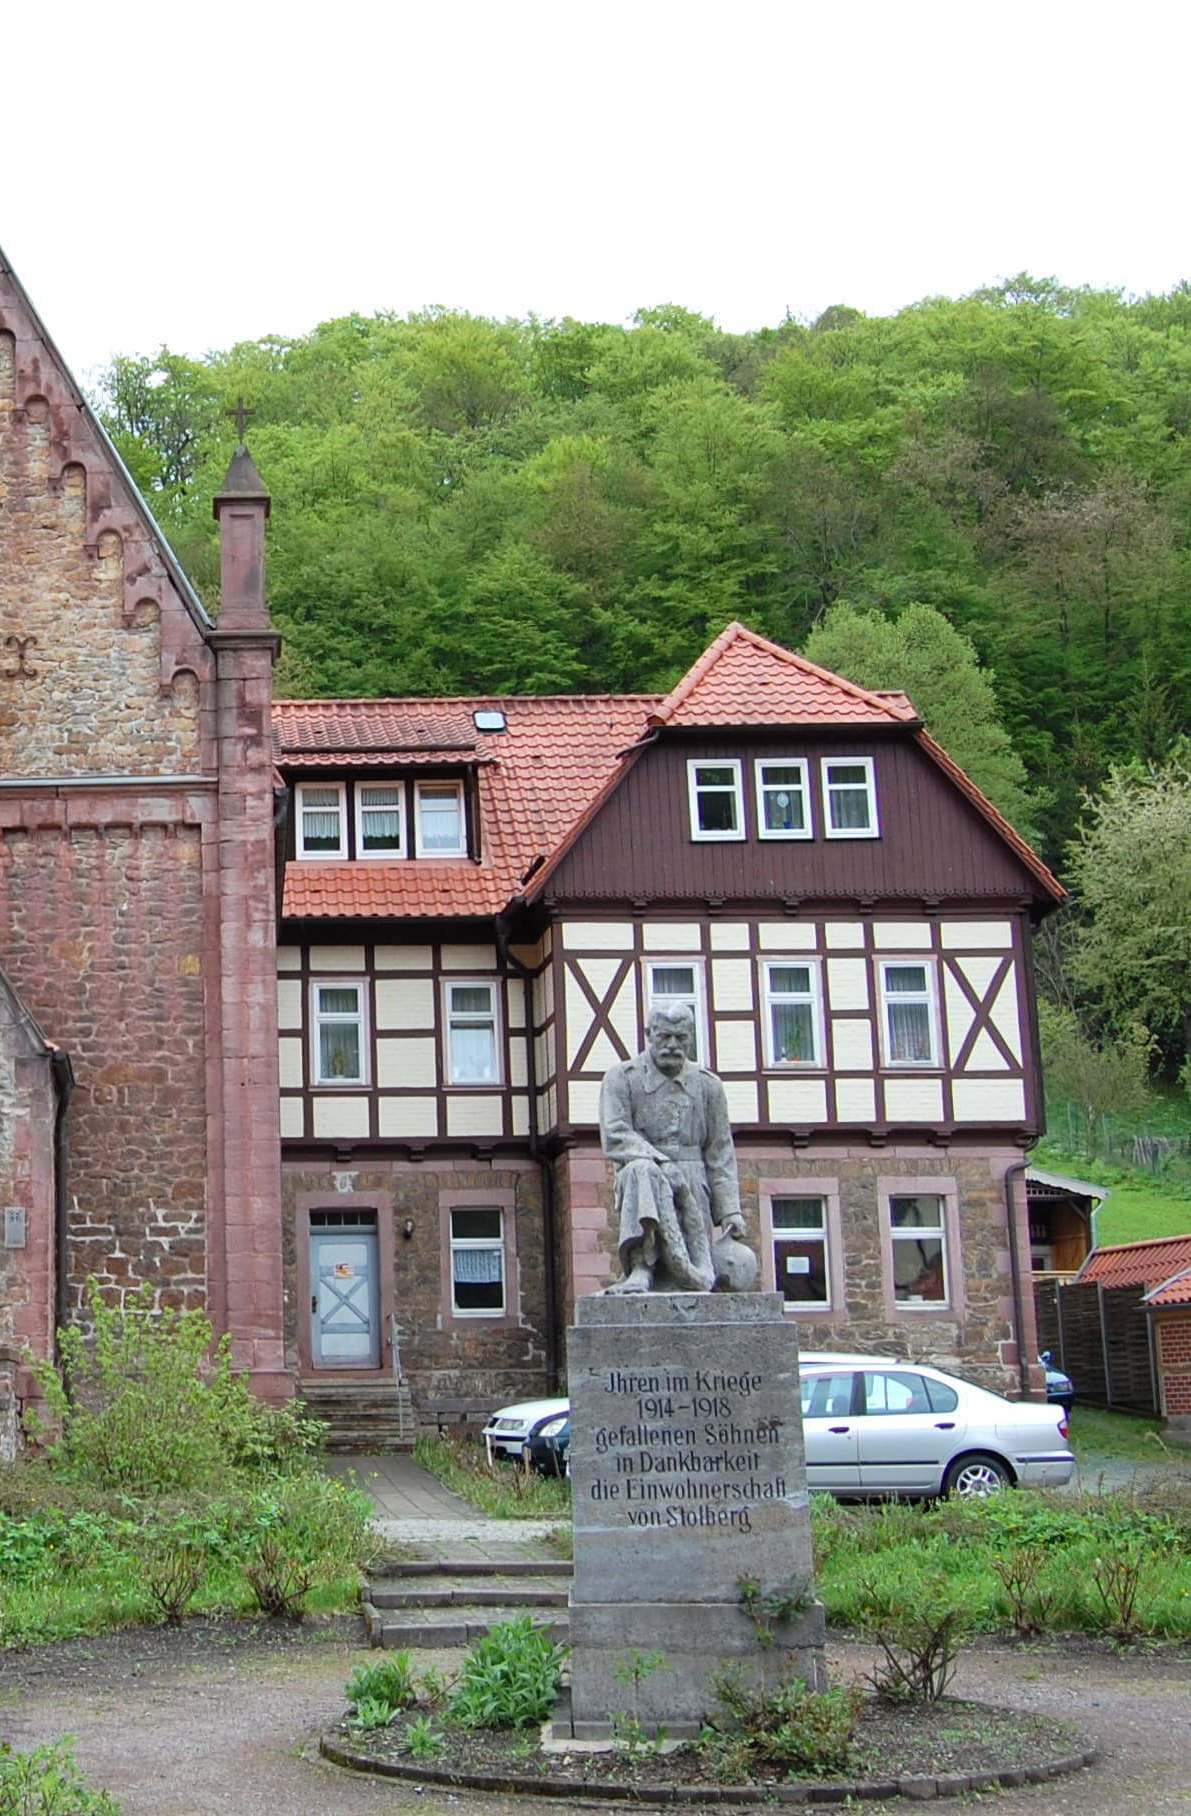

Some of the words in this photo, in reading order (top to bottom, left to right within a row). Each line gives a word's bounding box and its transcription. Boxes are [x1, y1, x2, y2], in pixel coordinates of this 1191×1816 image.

[666, 1371, 689, 1391] im
[696, 1371, 762, 1396] Kriege
[596, 1424, 696, 1452] gefallenen
[705, 1423, 780, 1445] Söhnen
[616, 1452, 633, 1473] in
[640, 1450, 760, 1473] Dankbarkeit
[591, 1478, 619, 1501] die
[627, 1476, 787, 1500] Einwohnerschaft
[628, 1511, 660, 1527] von
[666, 1505, 752, 1534] Stolberg
